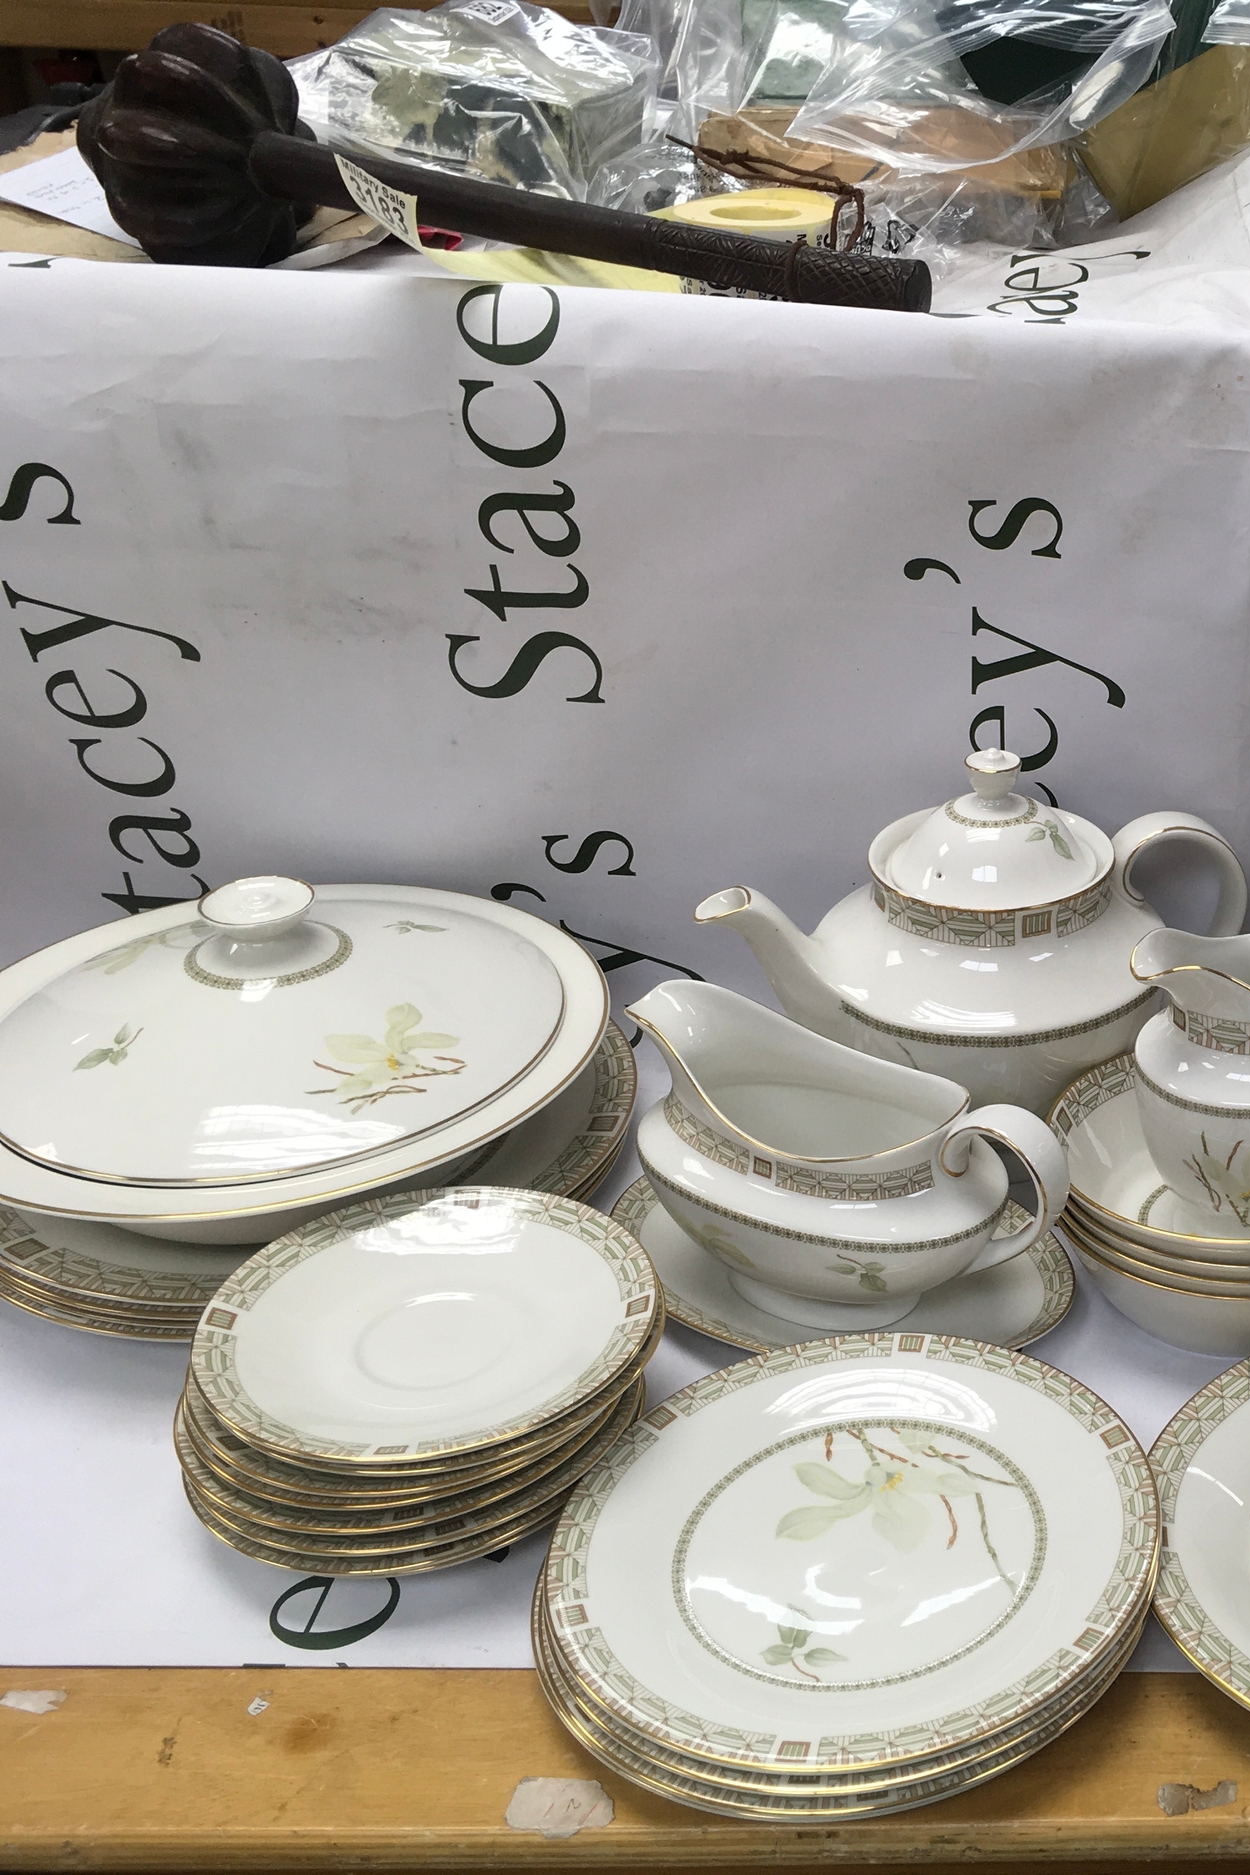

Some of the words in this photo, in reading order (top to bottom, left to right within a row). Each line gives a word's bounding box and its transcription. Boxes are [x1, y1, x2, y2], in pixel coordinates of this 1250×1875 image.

[340, 158, 379, 193] Military
[381, 186, 406, 210] Sale
[349, 175, 409, 236] 3183
[445, 284, 606, 704] Stace
[0, 462, 211, 915] taceys
[904, 497, 1126, 772] ey's
